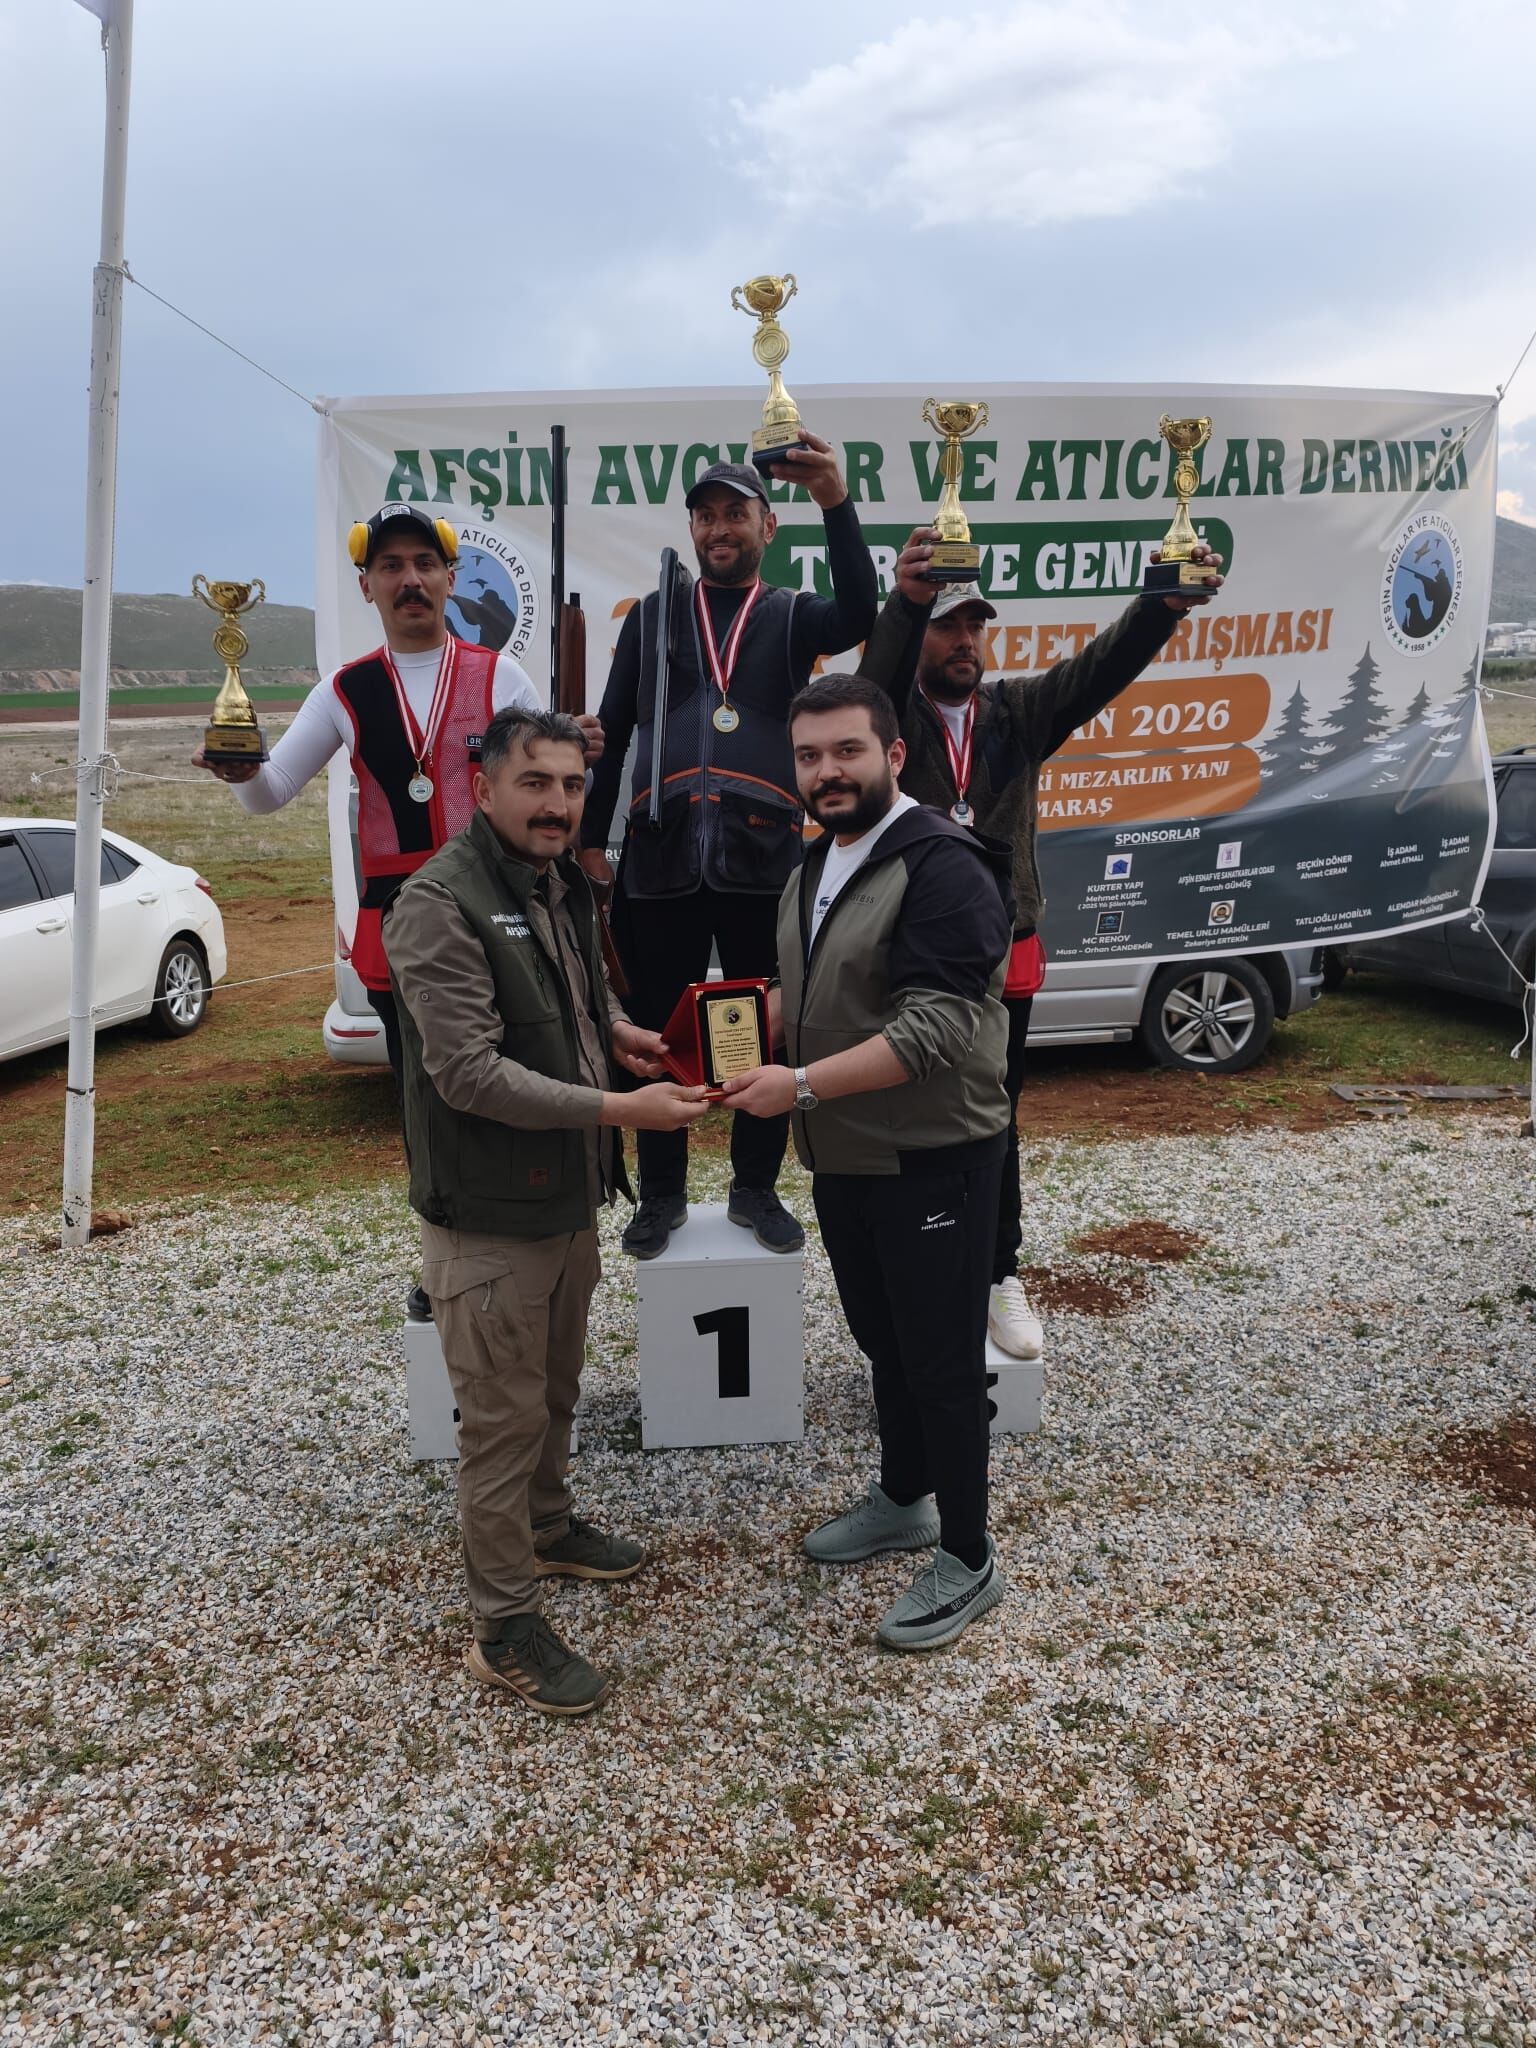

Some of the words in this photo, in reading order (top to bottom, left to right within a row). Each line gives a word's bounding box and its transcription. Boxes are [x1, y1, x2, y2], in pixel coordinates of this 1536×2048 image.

[384, 430, 571, 522] AFŞİN
[909, 440, 998, 502] VE
[1299, 427, 1470, 495] DERNEĞİ
[1385, 524, 1415, 584] AVCILAR
[1415, 515, 1428, 529] VE
[460, 529, 525, 579] ATICILAR
[509, 581, 534, 660] DERNEĞİ
[1128, 699, 1231, 738] 2026
[1058, 765, 1174, 791] MEZARLIK
[1180, 760, 1231, 781] YANI
[1114, 827, 1201, 846] SPONSORLAR
[1296, 857, 1325, 871] SEÇKİN
[1325, 854, 1353, 867] DÖNER
[1300, 871, 1324, 880] Ahmet
[1324, 866, 1348, 877] CERAN
[1087, 883, 1122, 893] KURTER
[1123, 881, 1144, 890] YAPI
[1085, 894, 1119, 903] Mehmet
[1120, 892, 1142, 900] KURT
[1295, 912, 1337, 926] TATLIOĞLU
[1338, 908, 1372, 921] MOBİLYA
[1082, 937, 1097, 945] MC
[1099, 934, 1131, 944] RENOV
[1166, 931, 1194, 940] TEMEL
[1196, 927, 1219, 937] UNLU
[1220, 921, 1271, 935] MAMÜLLERİ
[1056, 947, 1077, 956] Musa
[1085, 946, 1109, 954] Orhan
[1110, 941, 1153, 952] CANDEMİR
[693, 1306, 751, 1399] 1
